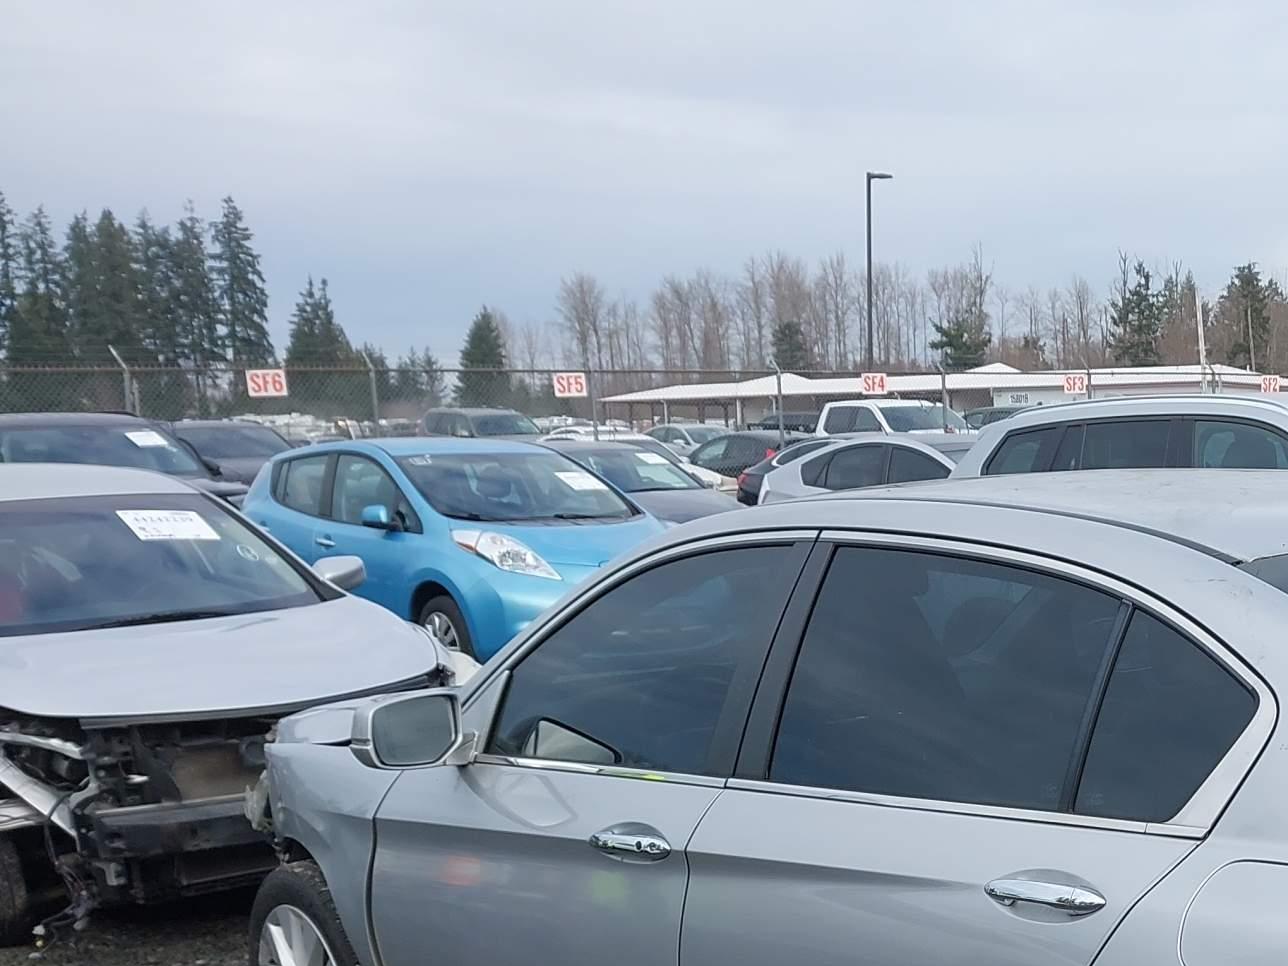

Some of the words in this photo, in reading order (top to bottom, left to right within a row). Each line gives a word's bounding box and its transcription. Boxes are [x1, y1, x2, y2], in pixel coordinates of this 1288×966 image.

[250, 373, 284, 393] SF6
[556, 375, 584, 393] SF5
[863, 375, 885, 392] SF4
[1066, 376, 1084, 391] SF3
[1262, 377, 1278, 393] SF2
